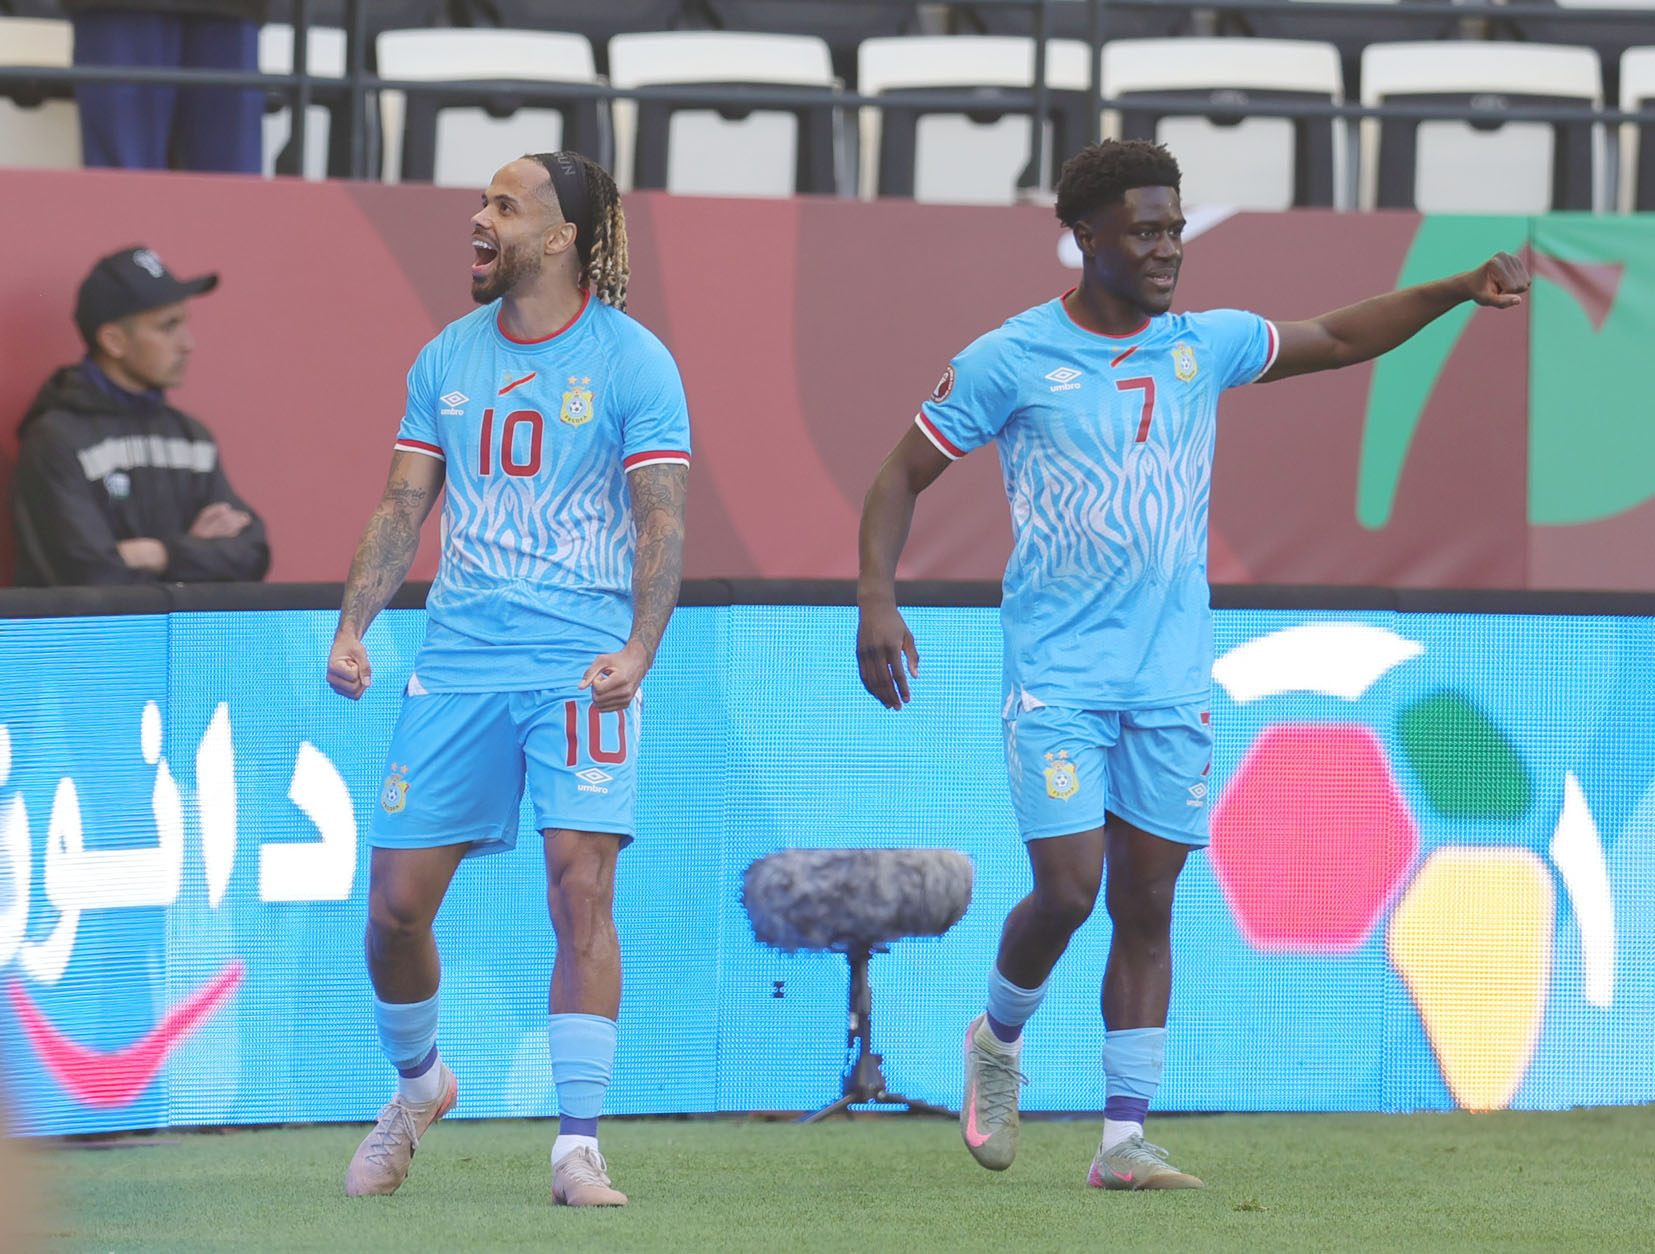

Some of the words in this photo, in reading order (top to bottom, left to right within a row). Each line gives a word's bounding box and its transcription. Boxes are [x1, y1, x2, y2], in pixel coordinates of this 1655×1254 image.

[1050, 382, 1082, 392] umbro
[440, 408, 465, 416] umbro
[1115, 376, 1156, 444] 7
[479, 408, 545, 478] 10
[564, 700, 628, 768] 10
[577, 783, 609, 794] umbro
